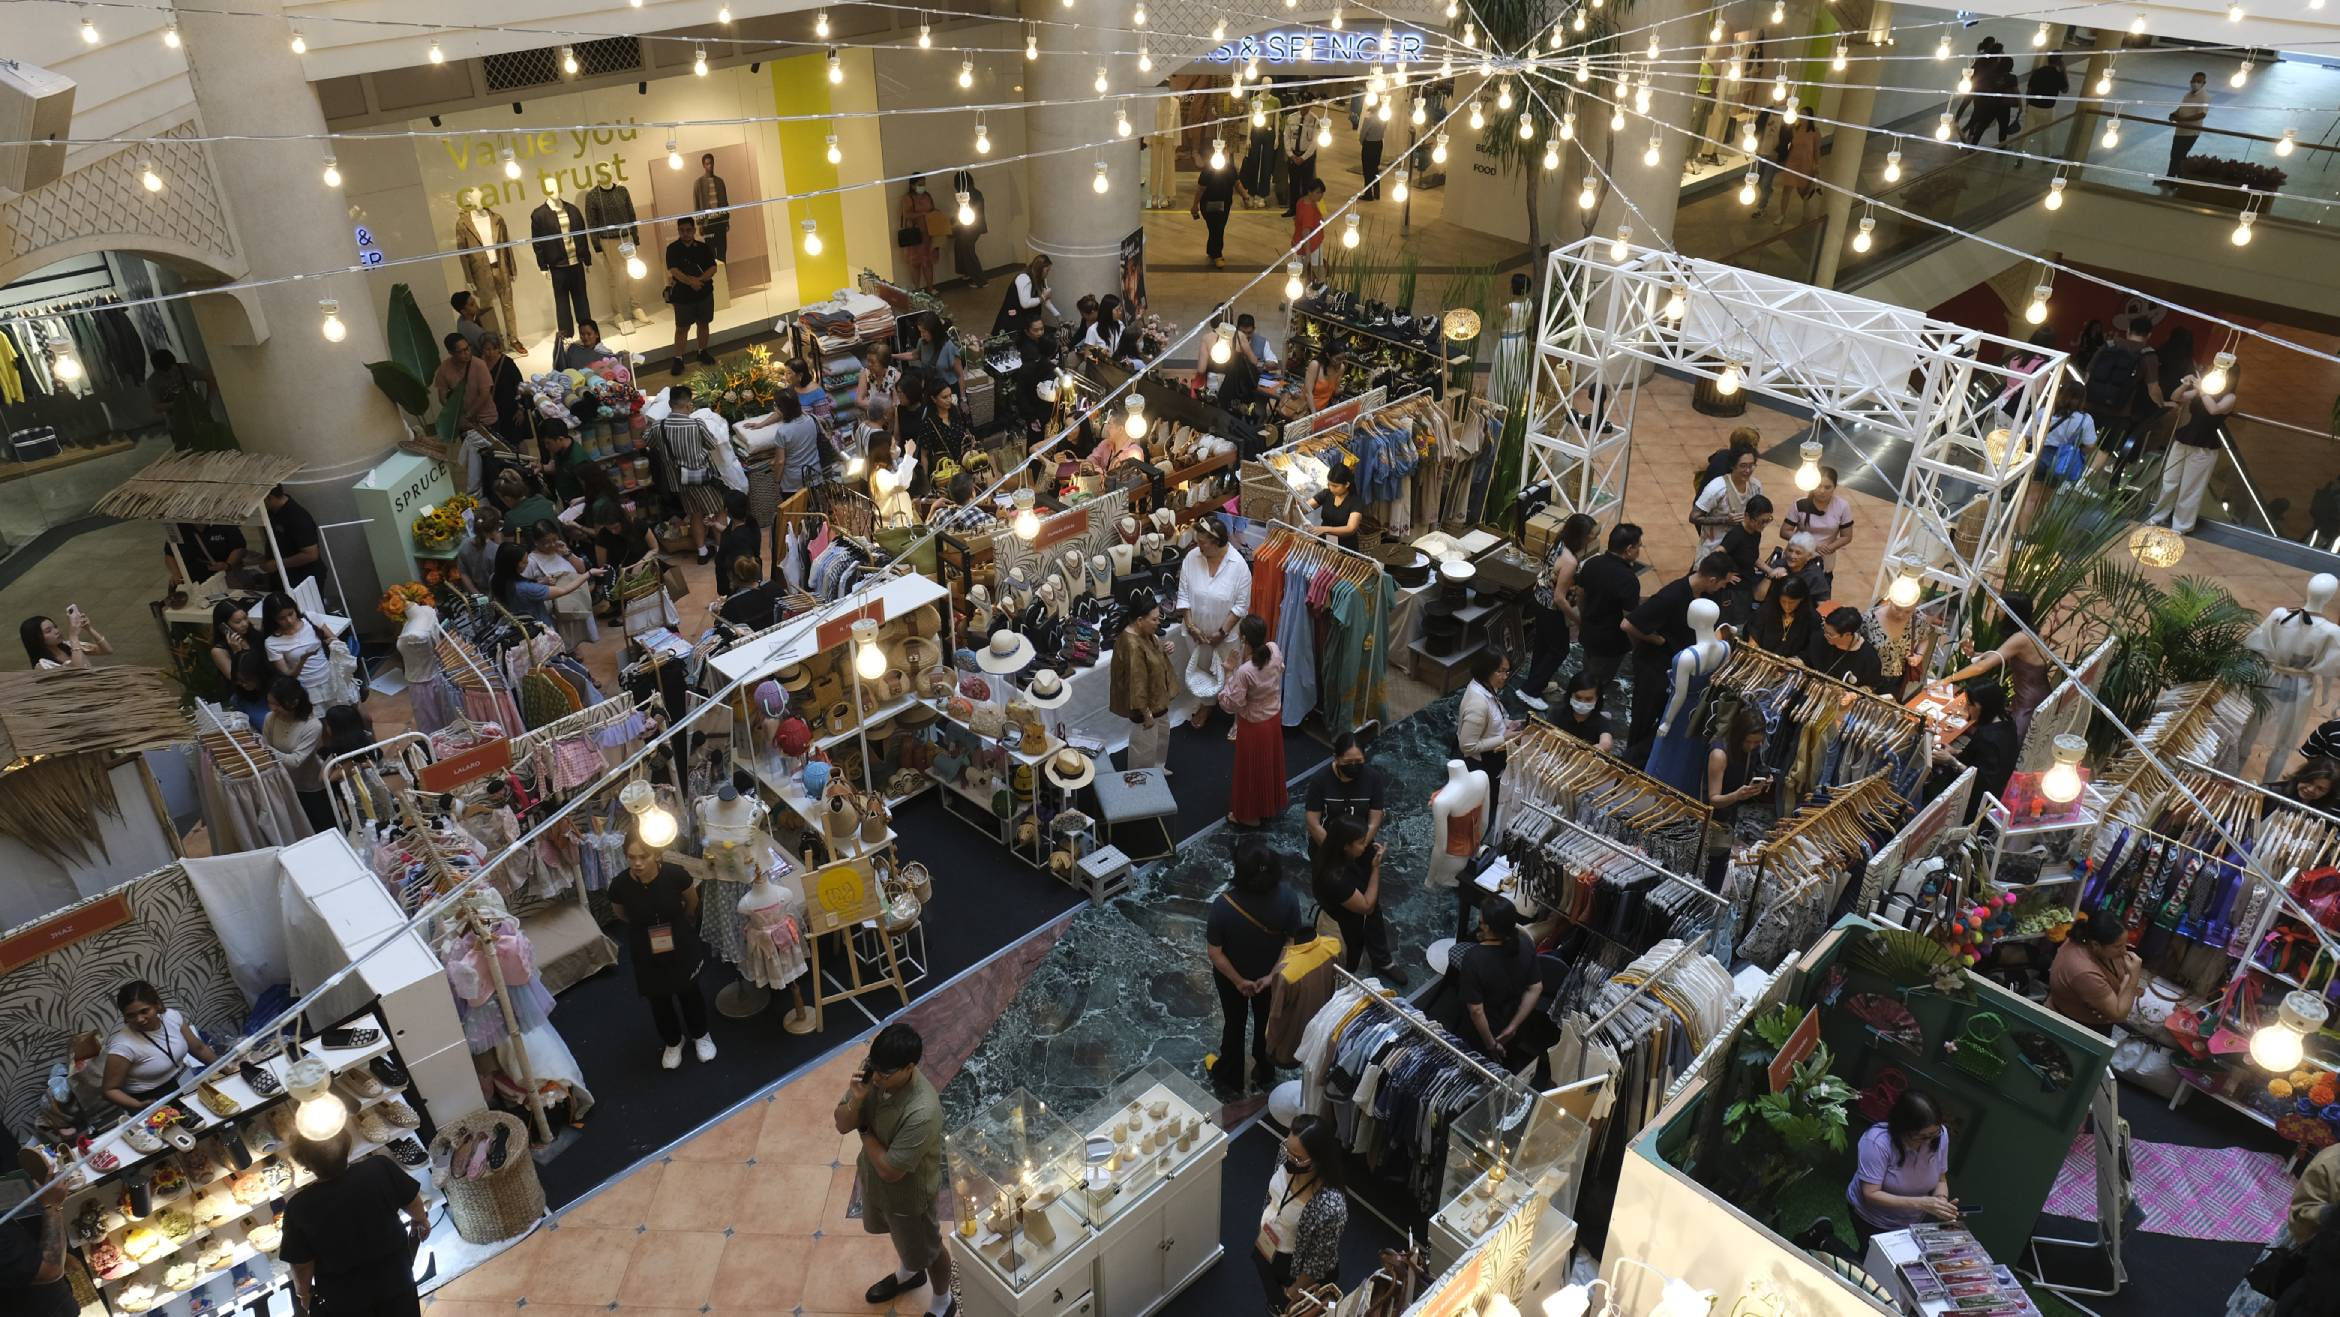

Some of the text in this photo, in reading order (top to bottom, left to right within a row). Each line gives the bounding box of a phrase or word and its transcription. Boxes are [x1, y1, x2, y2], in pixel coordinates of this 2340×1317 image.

[570, 117, 637, 159] you
[456, 152, 629, 212] can trust
[1473, 163, 1497, 176] FOOD
[358, 229, 374, 246] &
[394, 460, 447, 513] SPRUCE
